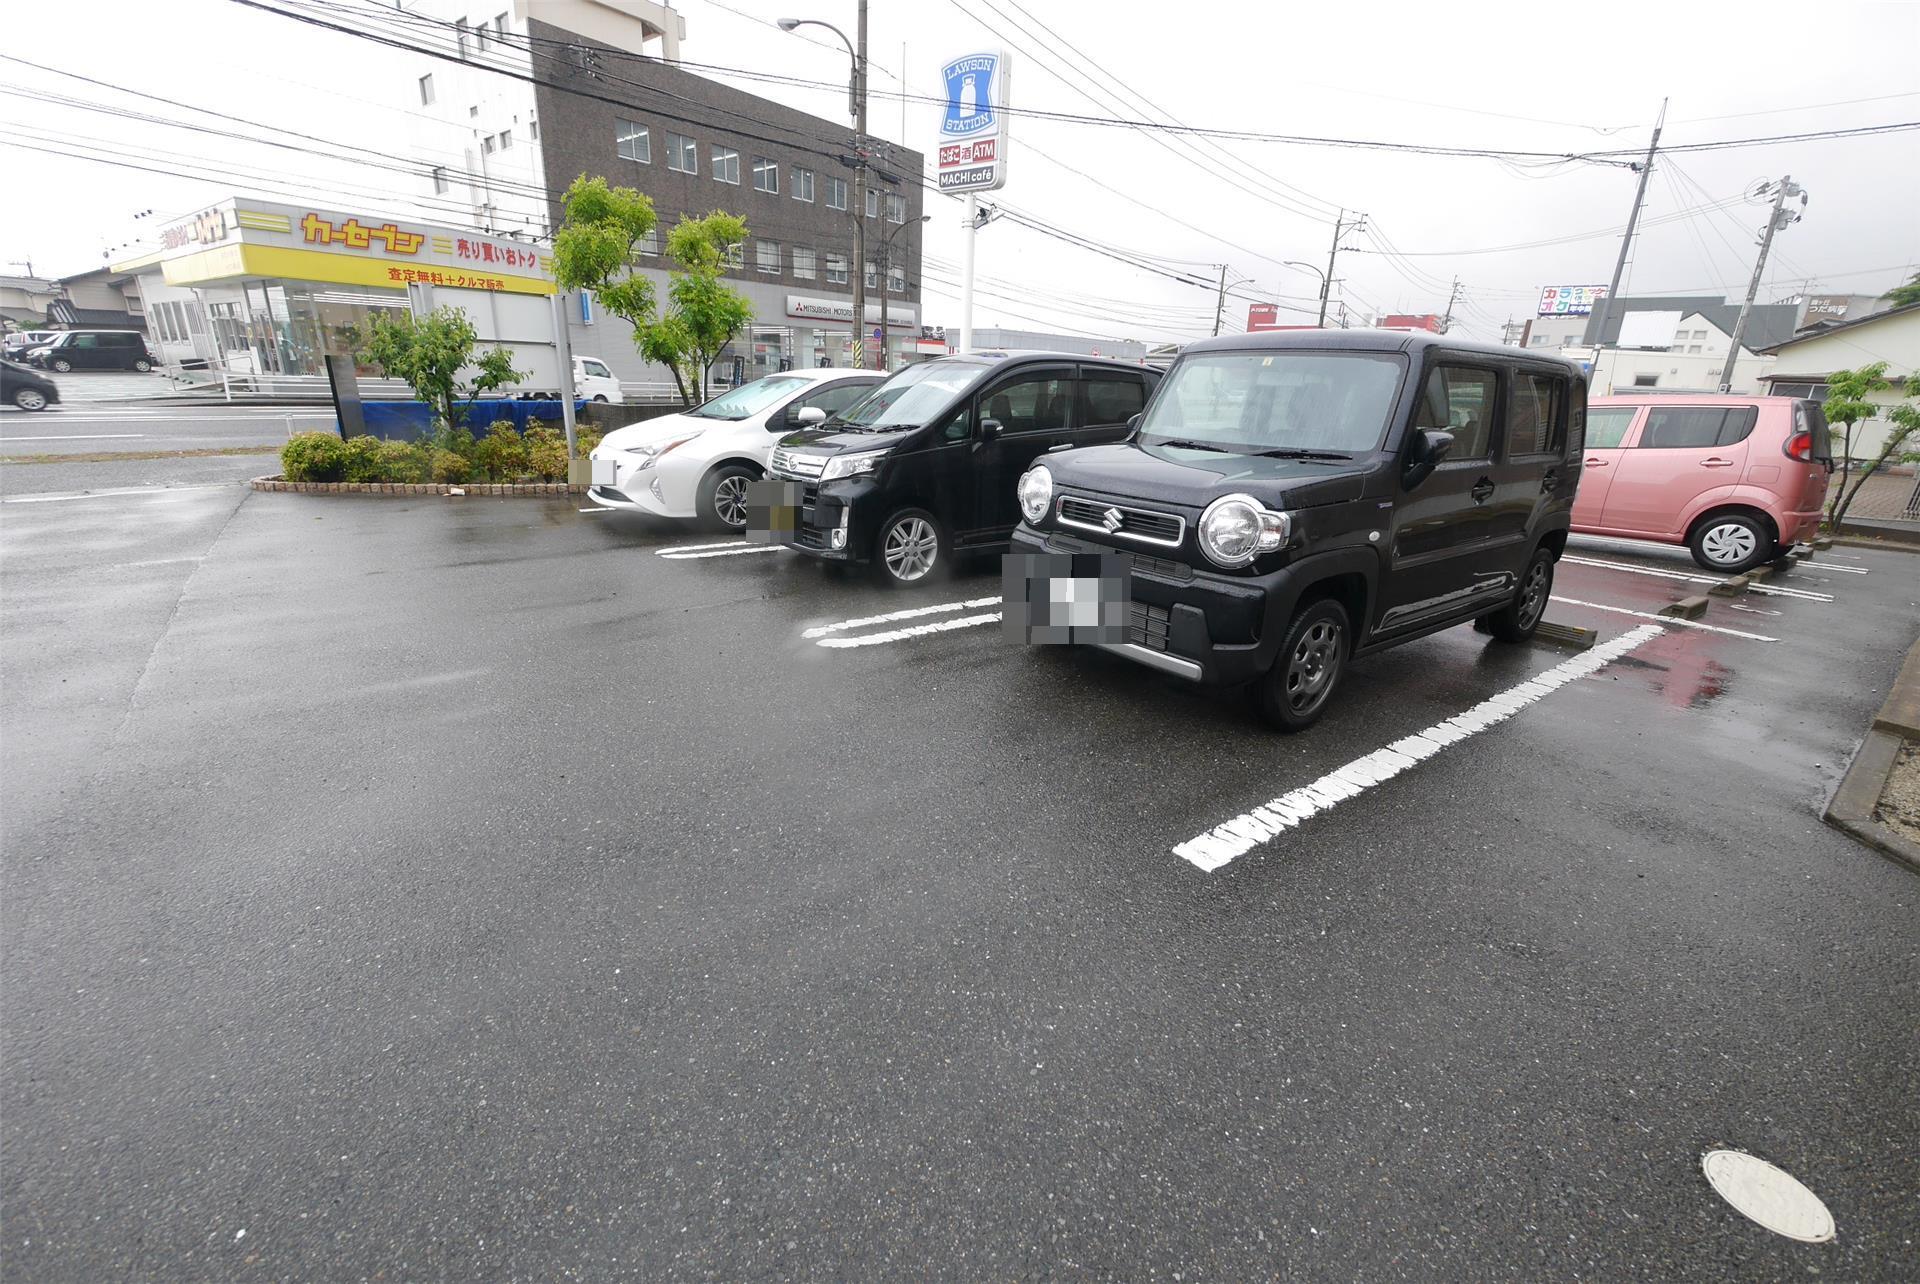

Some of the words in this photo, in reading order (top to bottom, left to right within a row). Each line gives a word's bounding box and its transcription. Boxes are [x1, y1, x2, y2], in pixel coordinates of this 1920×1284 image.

[947, 59, 992, 80] LAWSON
[946, 112, 989, 131] STATION
[940, 147, 960, 164] たばこ
[961, 146, 972, 161] 酒
[973, 142, 994, 159] ATM
[940, 171, 970, 186] MACHI
[971, 169, 992, 182] café
[301, 212, 425, 255] カーセブン
[457, 238, 536, 269] 売り買いおトク
[803, 304, 832, 315] MITSUBISHI
[833, 308, 853, 317] MOTORS
